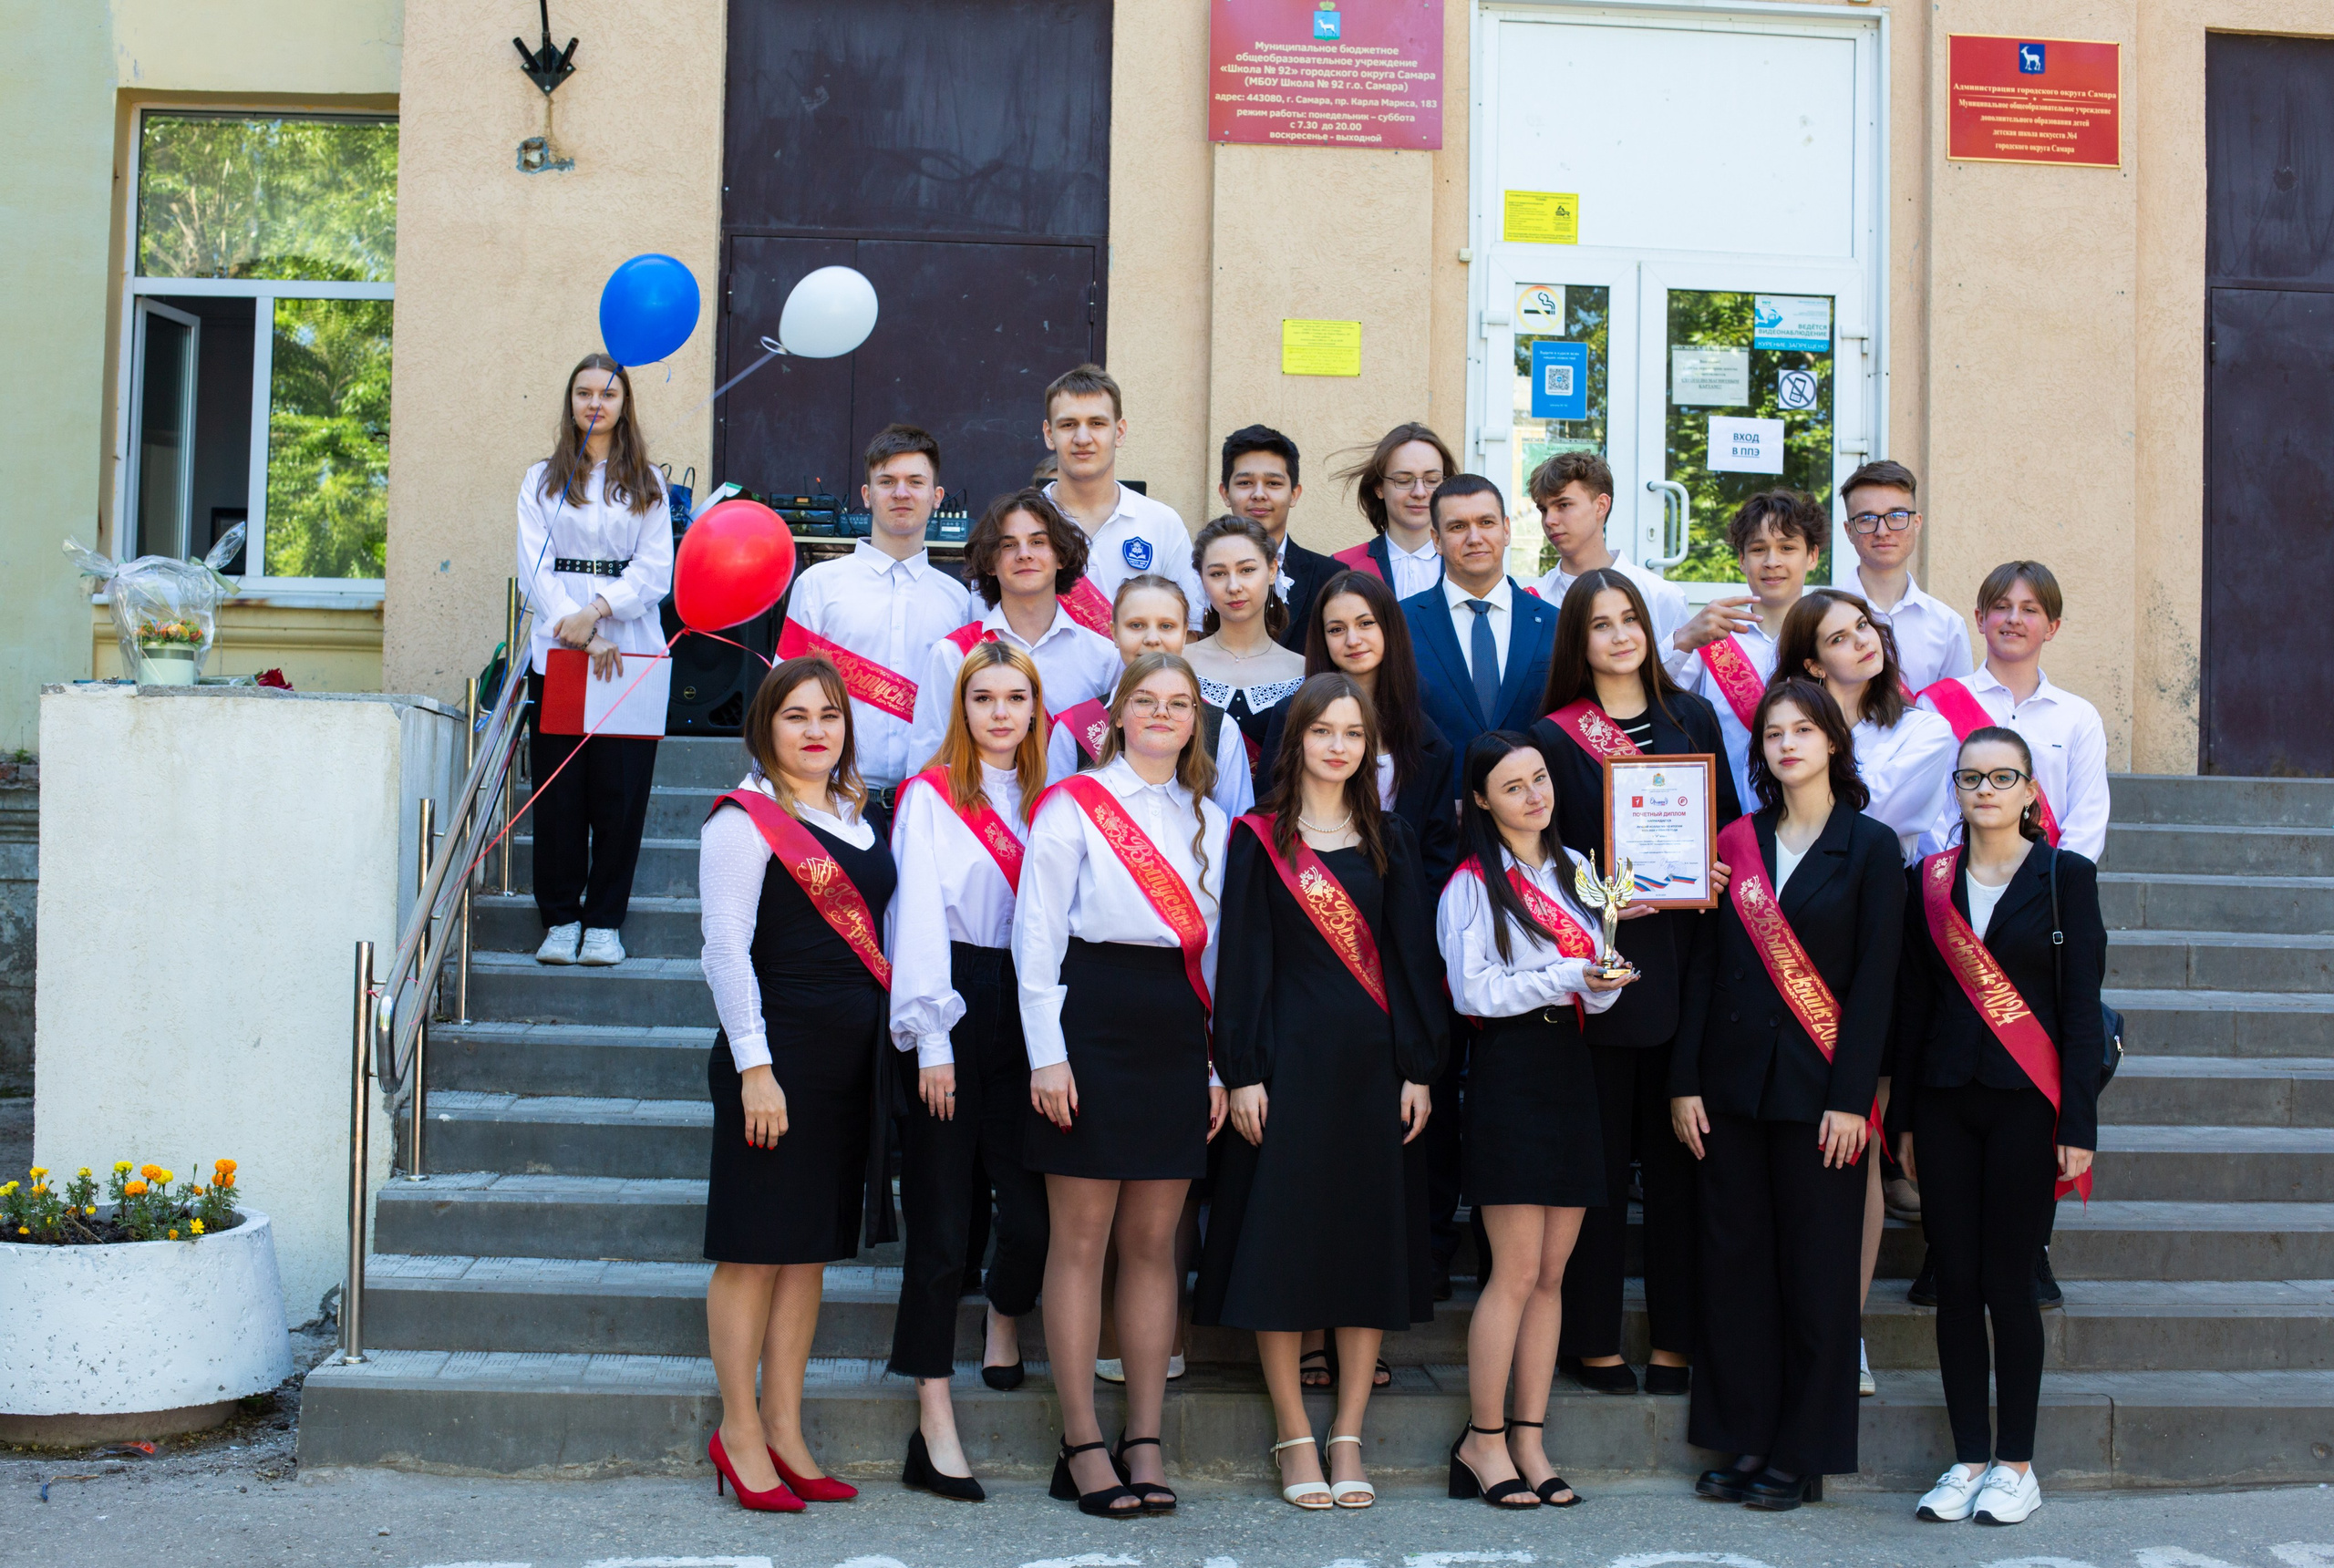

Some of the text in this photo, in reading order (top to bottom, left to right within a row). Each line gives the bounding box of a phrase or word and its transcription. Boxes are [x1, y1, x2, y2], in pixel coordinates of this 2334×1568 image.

[1255, 42, 1399, 55] Муниципальное бюджетное
[1235, 53, 1418, 67] общеобразовательное учреждение
[1221, 64, 1436, 81] «Школа № 92» городского округа Самара
[1244, 77, 1278, 87] (МБОУ
[1281, 78, 1314, 88] Школа
[1317, 79, 1328, 88] №
[1331, 80, 1344, 88] 92
[1366, 81, 1408, 92] Самара)
[1954, 83, 2015, 93] Администрация
[2088, 90, 2116, 99] Самара
[1215, 94, 1244, 102] адрес:
[1246, 94, 1285, 103] 443080,
[1296, 96, 1333, 105] Самара,
[1335, 98, 1348, 107] пр.
[1351, 98, 1379, 107] Карла
[1381, 98, 1418, 108] Маркса,
[1958, 98, 2111, 115] Муниципальное общеобразовательное учреждение
[1269, 109, 1306, 119] работы:
[1308, 111, 1368, 120] понедельник
[1378, 113, 1415, 122] суббота
[1297, 120, 1317, 129] 7.30
[1321, 123, 1333, 131] до
[1336, 122, 1362, 131] 20.00
[1270, 131, 1327, 140] воскресенье
[1336, 133, 1381, 142] выходной
[2029, 145, 2050, 153] округа
[2051, 145, 2074, 154] Самара
[1733, 433, 1760, 443] ВХОД
[1740, 448, 1760, 456] ППЭ
[836, 655, 916, 711] Выпускн
[1751, 907, 1833, 1021] Выпускник
[1976, 982, 2031, 1027] 2024
